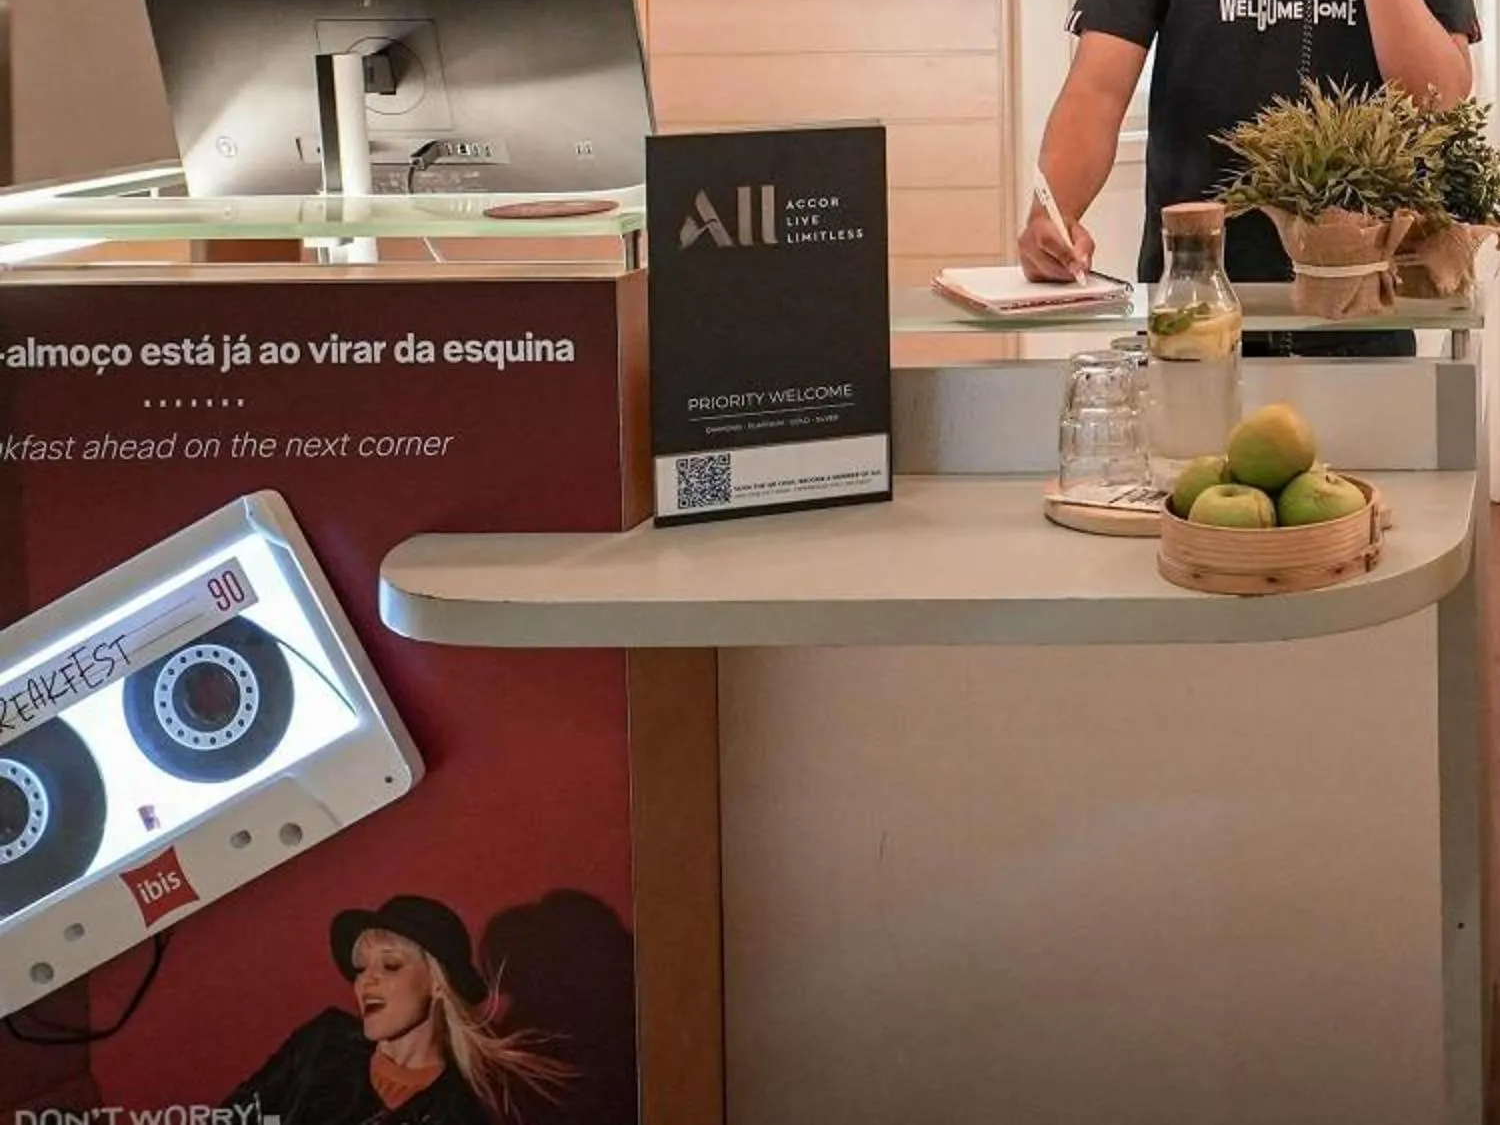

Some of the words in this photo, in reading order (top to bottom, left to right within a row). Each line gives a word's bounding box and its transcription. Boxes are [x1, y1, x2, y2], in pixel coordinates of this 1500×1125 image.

[785, 198, 839, 210] ACCOR
[786, 214, 820, 226] LIVE
[787, 228, 864, 244] LIMITLESS
[140, 334, 215, 366] está
[220, 334, 252, 373] já
[258, 341, 300, 366] ao
[308, 333, 386, 364] virar
[394, 332, 435, 363] da
[443, 331, 575, 370] esquina
[688, 391, 765, 412] PRIORITY
[769, 383, 854, 403] WELCOME
[0, 435, 76, 460] kfast
[82, 433, 177, 460] ahead
[184, 438, 221, 459] on
[230, 432, 283, 459] the
[285, 432, 350, 459] next
[358, 435, 454, 457] corner
[207, 570, 245, 612] 90
[137, 869, 181, 904] ibis
